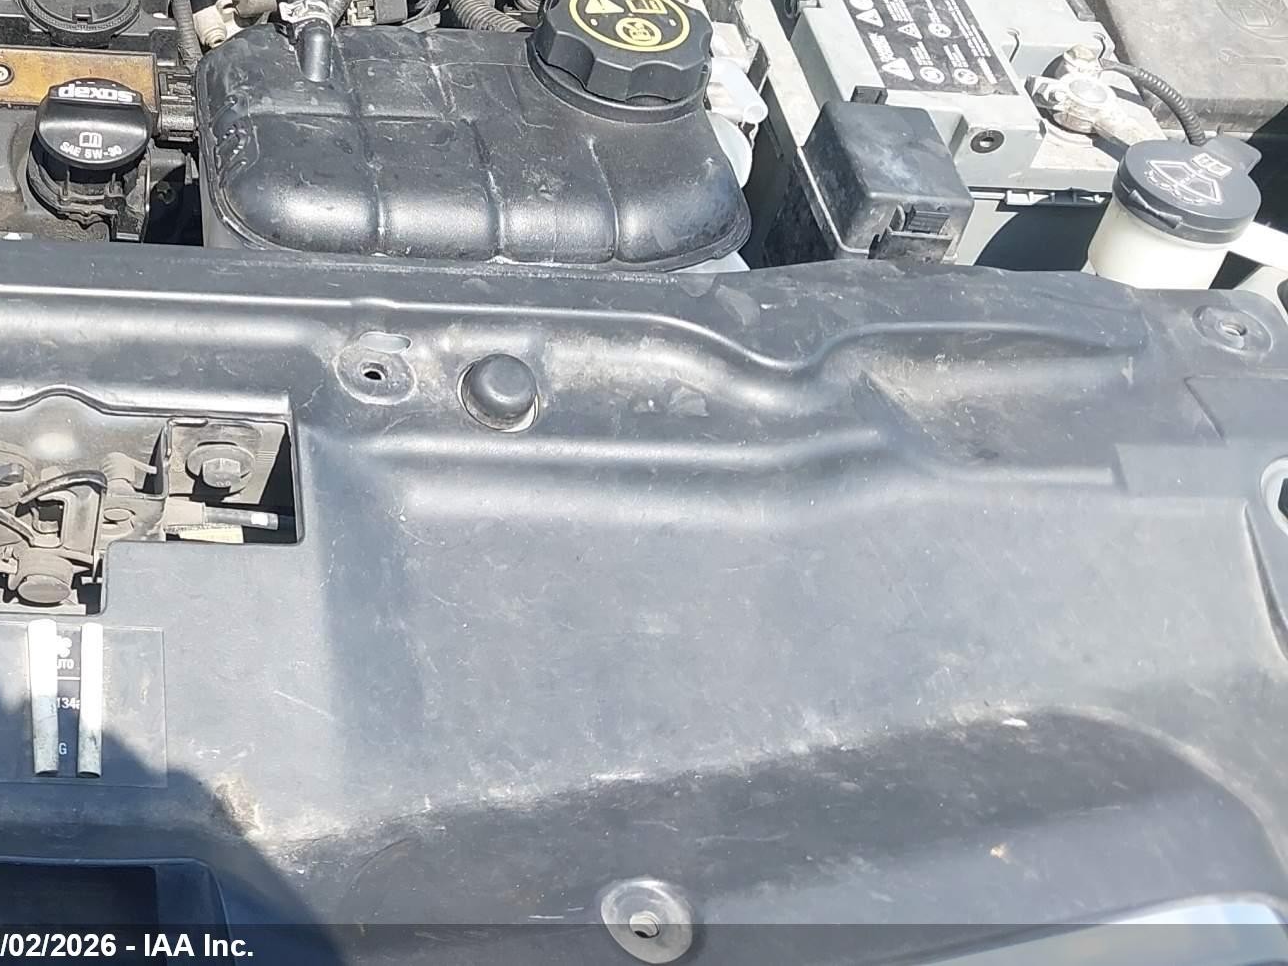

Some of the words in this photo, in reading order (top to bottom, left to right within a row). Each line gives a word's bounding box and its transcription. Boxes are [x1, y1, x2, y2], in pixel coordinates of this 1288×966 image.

[57, 83, 136, 103] dexos
[59, 141, 82, 157] SAE
[84, 144, 123, 160] 5W-30
[56, 658, 75, 670] UTO
[58, 742, 68, 756] G
